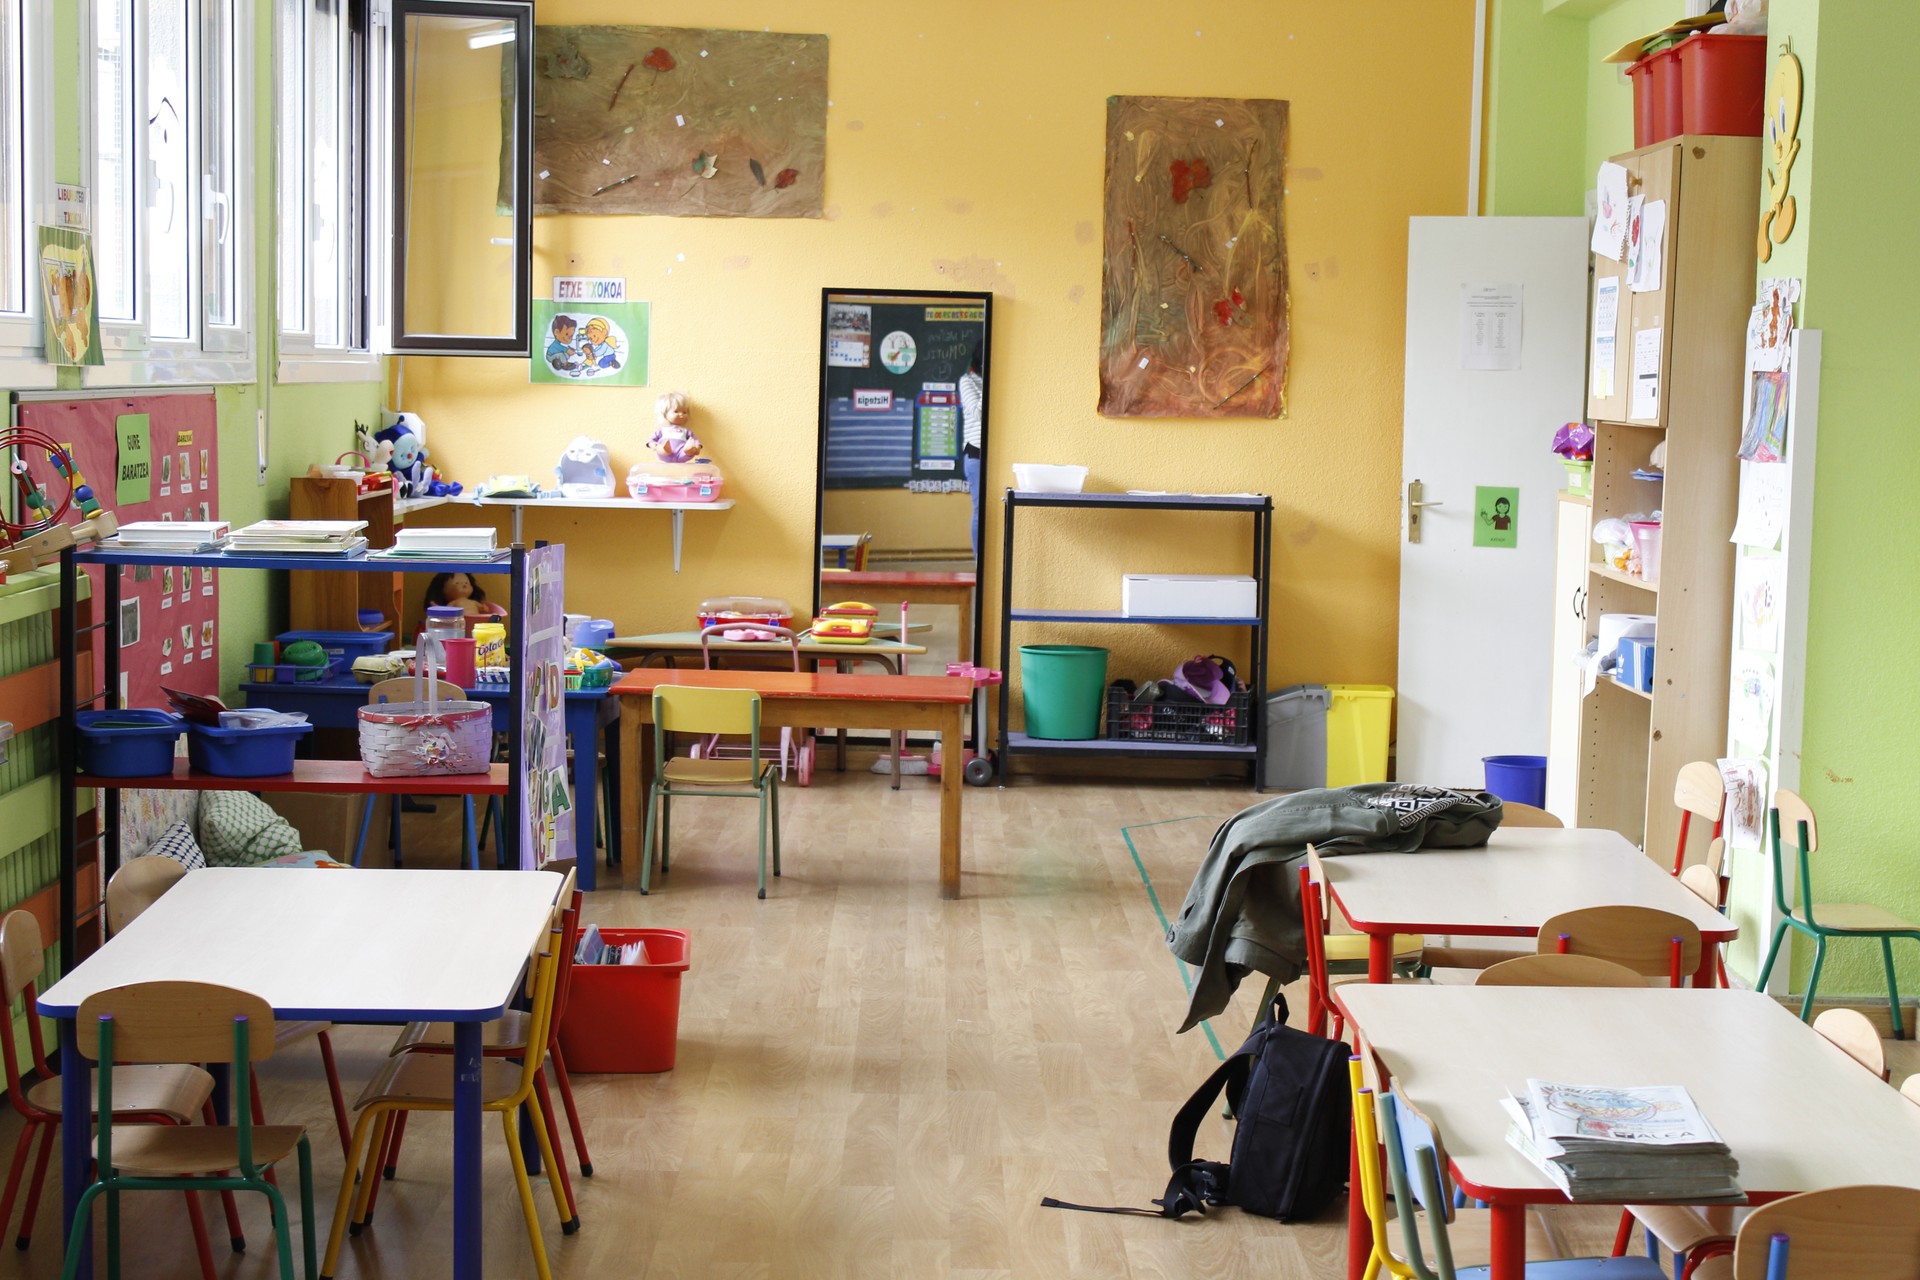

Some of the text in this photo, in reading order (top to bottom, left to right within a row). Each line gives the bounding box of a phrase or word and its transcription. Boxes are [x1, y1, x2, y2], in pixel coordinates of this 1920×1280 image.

[558, 280, 622, 299] ETXE TXOKOA
[126, 434, 141, 451] GURE
[121, 462, 150, 481] BARATZEA
